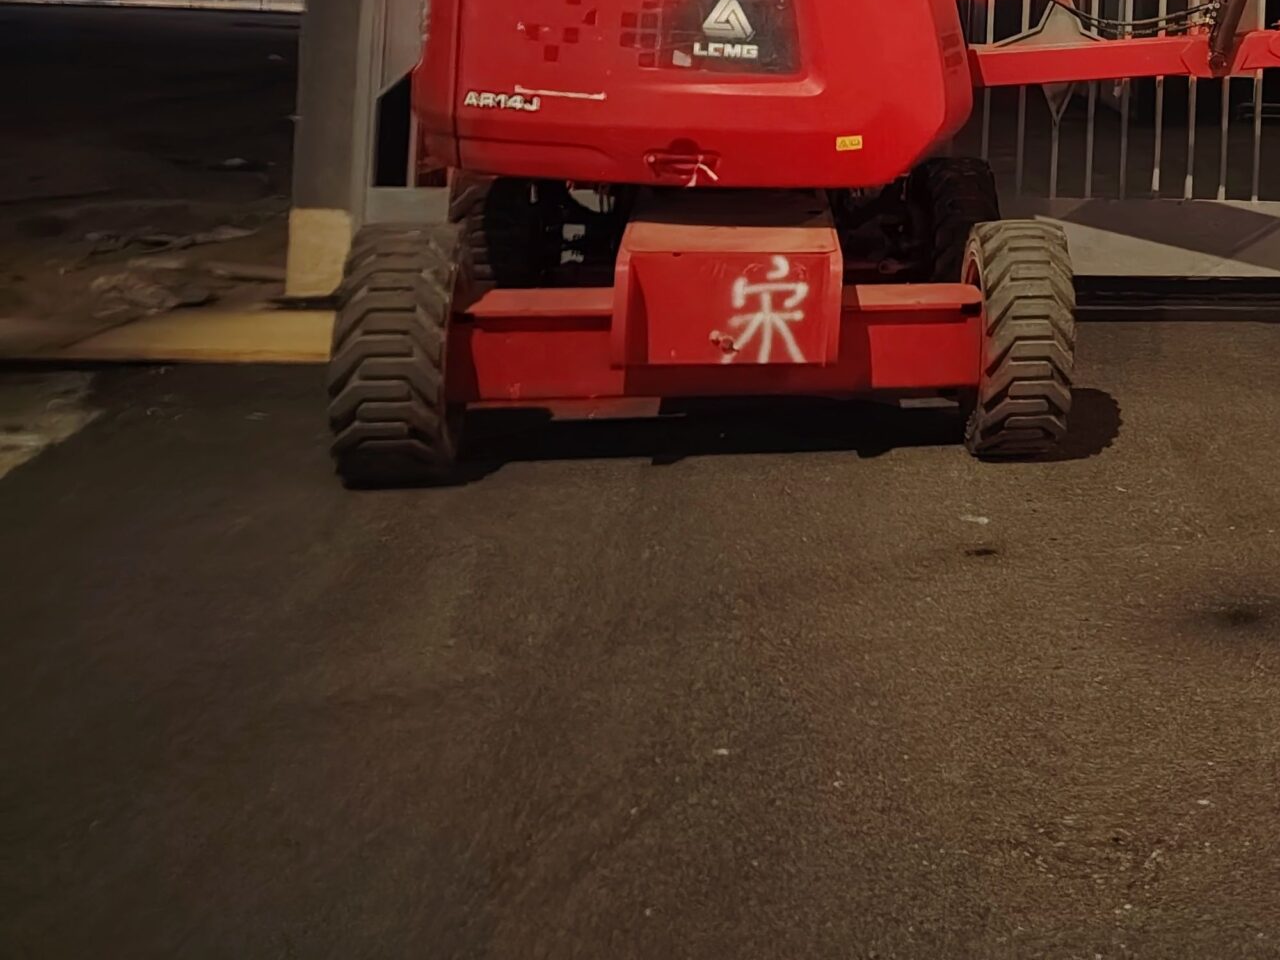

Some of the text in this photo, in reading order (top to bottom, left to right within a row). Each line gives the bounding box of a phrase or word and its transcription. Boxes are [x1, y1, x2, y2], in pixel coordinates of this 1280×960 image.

[693, 42, 759, 58] LCMG
[463, 90, 541, 111] AR14J
[720, 254, 809, 364] 宋
